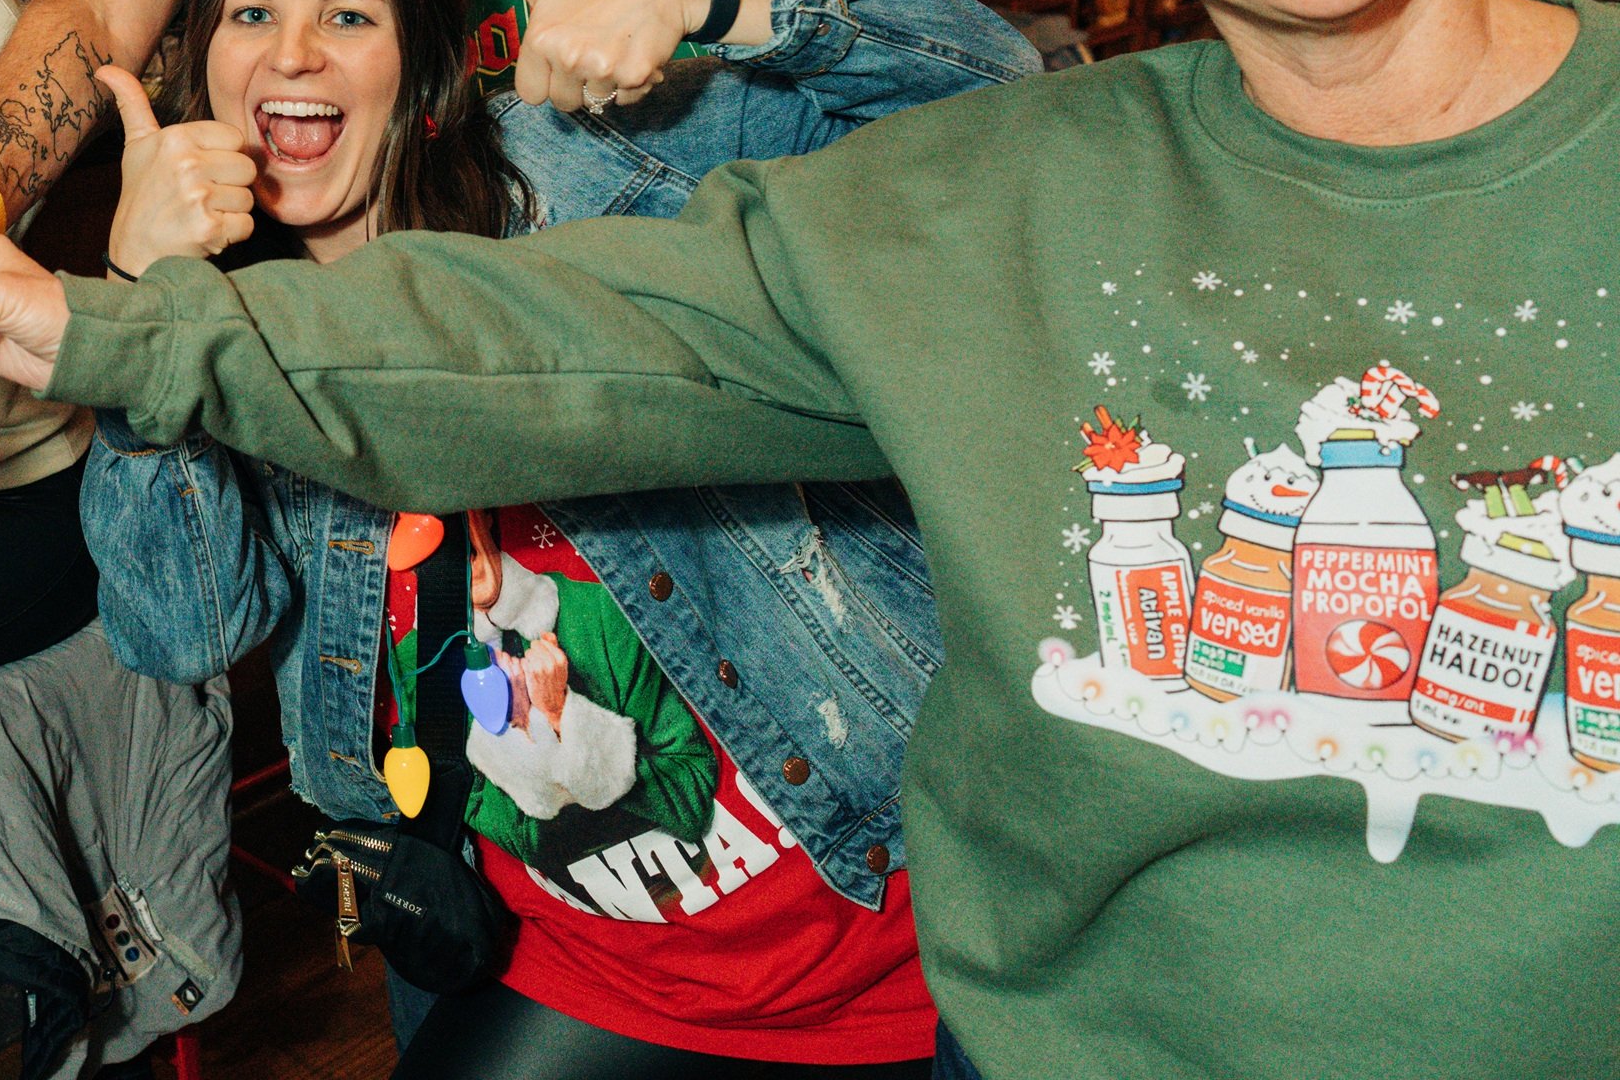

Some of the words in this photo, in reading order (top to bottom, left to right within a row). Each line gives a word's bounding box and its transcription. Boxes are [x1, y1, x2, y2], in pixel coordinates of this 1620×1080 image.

[1300, 549, 1432, 577] PEPPERMINT
[1160, 570, 1183, 618] APPLE
[1306, 568, 1426, 599] MOCHA
[1202, 588, 1245, 613] spiced
[1245, 602, 1286, 620] vanilla
[1301, 589, 1432, 622] PROPOFOL
[1137, 586, 1167, 660] Ativan
[1200, 607, 1282, 648] versed
[1436, 623, 1544, 668] HAZELNUT
[1575, 643, 1620, 667] spice
[1429, 643, 1534, 693] HALDOL
[384, 891, 423, 916] ZORFIN
